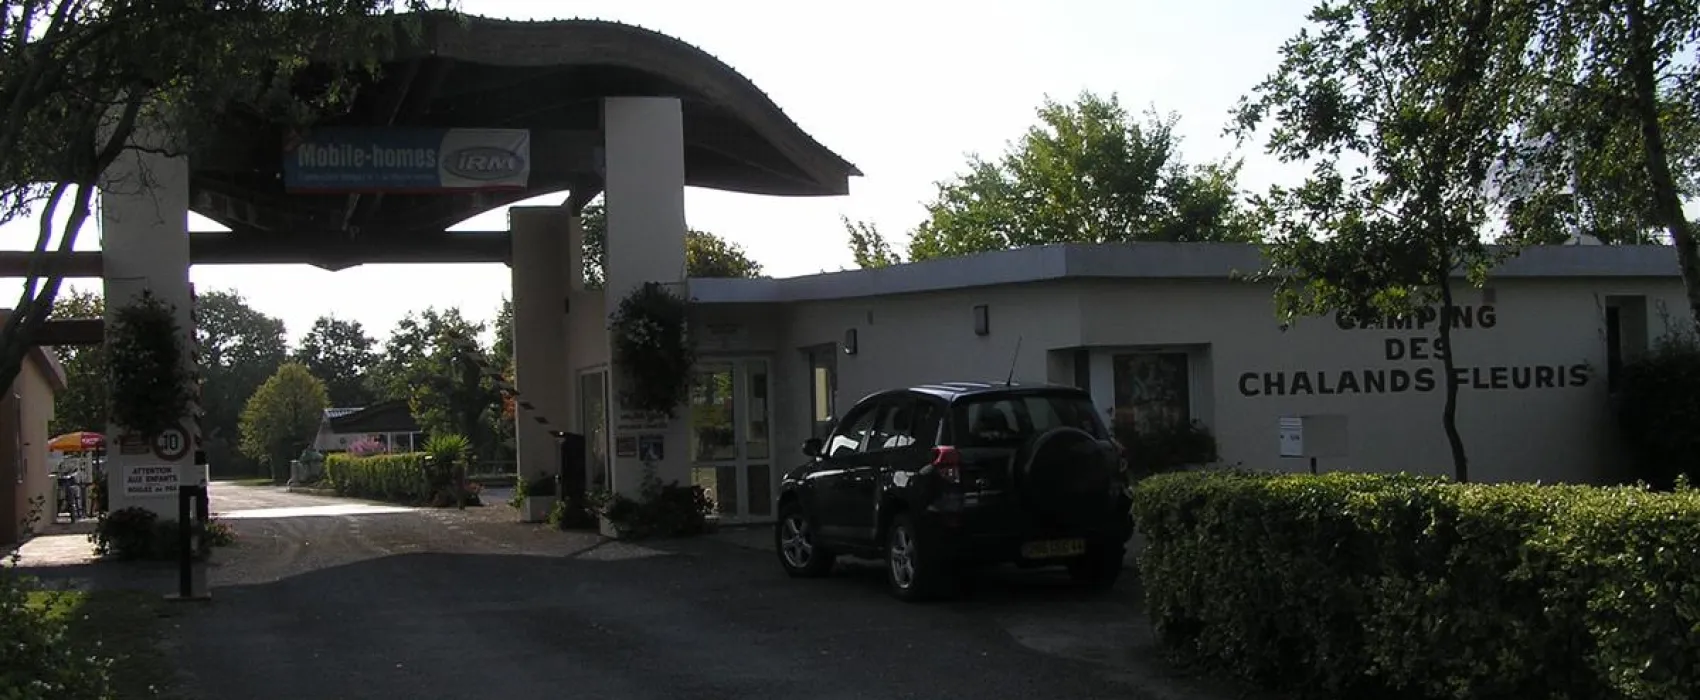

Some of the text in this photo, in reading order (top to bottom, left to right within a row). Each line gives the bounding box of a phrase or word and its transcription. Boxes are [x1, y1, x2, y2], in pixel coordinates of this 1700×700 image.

[297, 143, 436, 168] Mobile-homes
[1335, 305, 1497, 330] CAMPING
[1385, 337, 1451, 361] DES
[1238, 363, 1589, 397] CHALANDS FLEURIS
[162, 434, 178, 450] 10
[128, 474, 178, 483] AUX ENFANTS
[132, 467, 172, 475] ATTENTION
